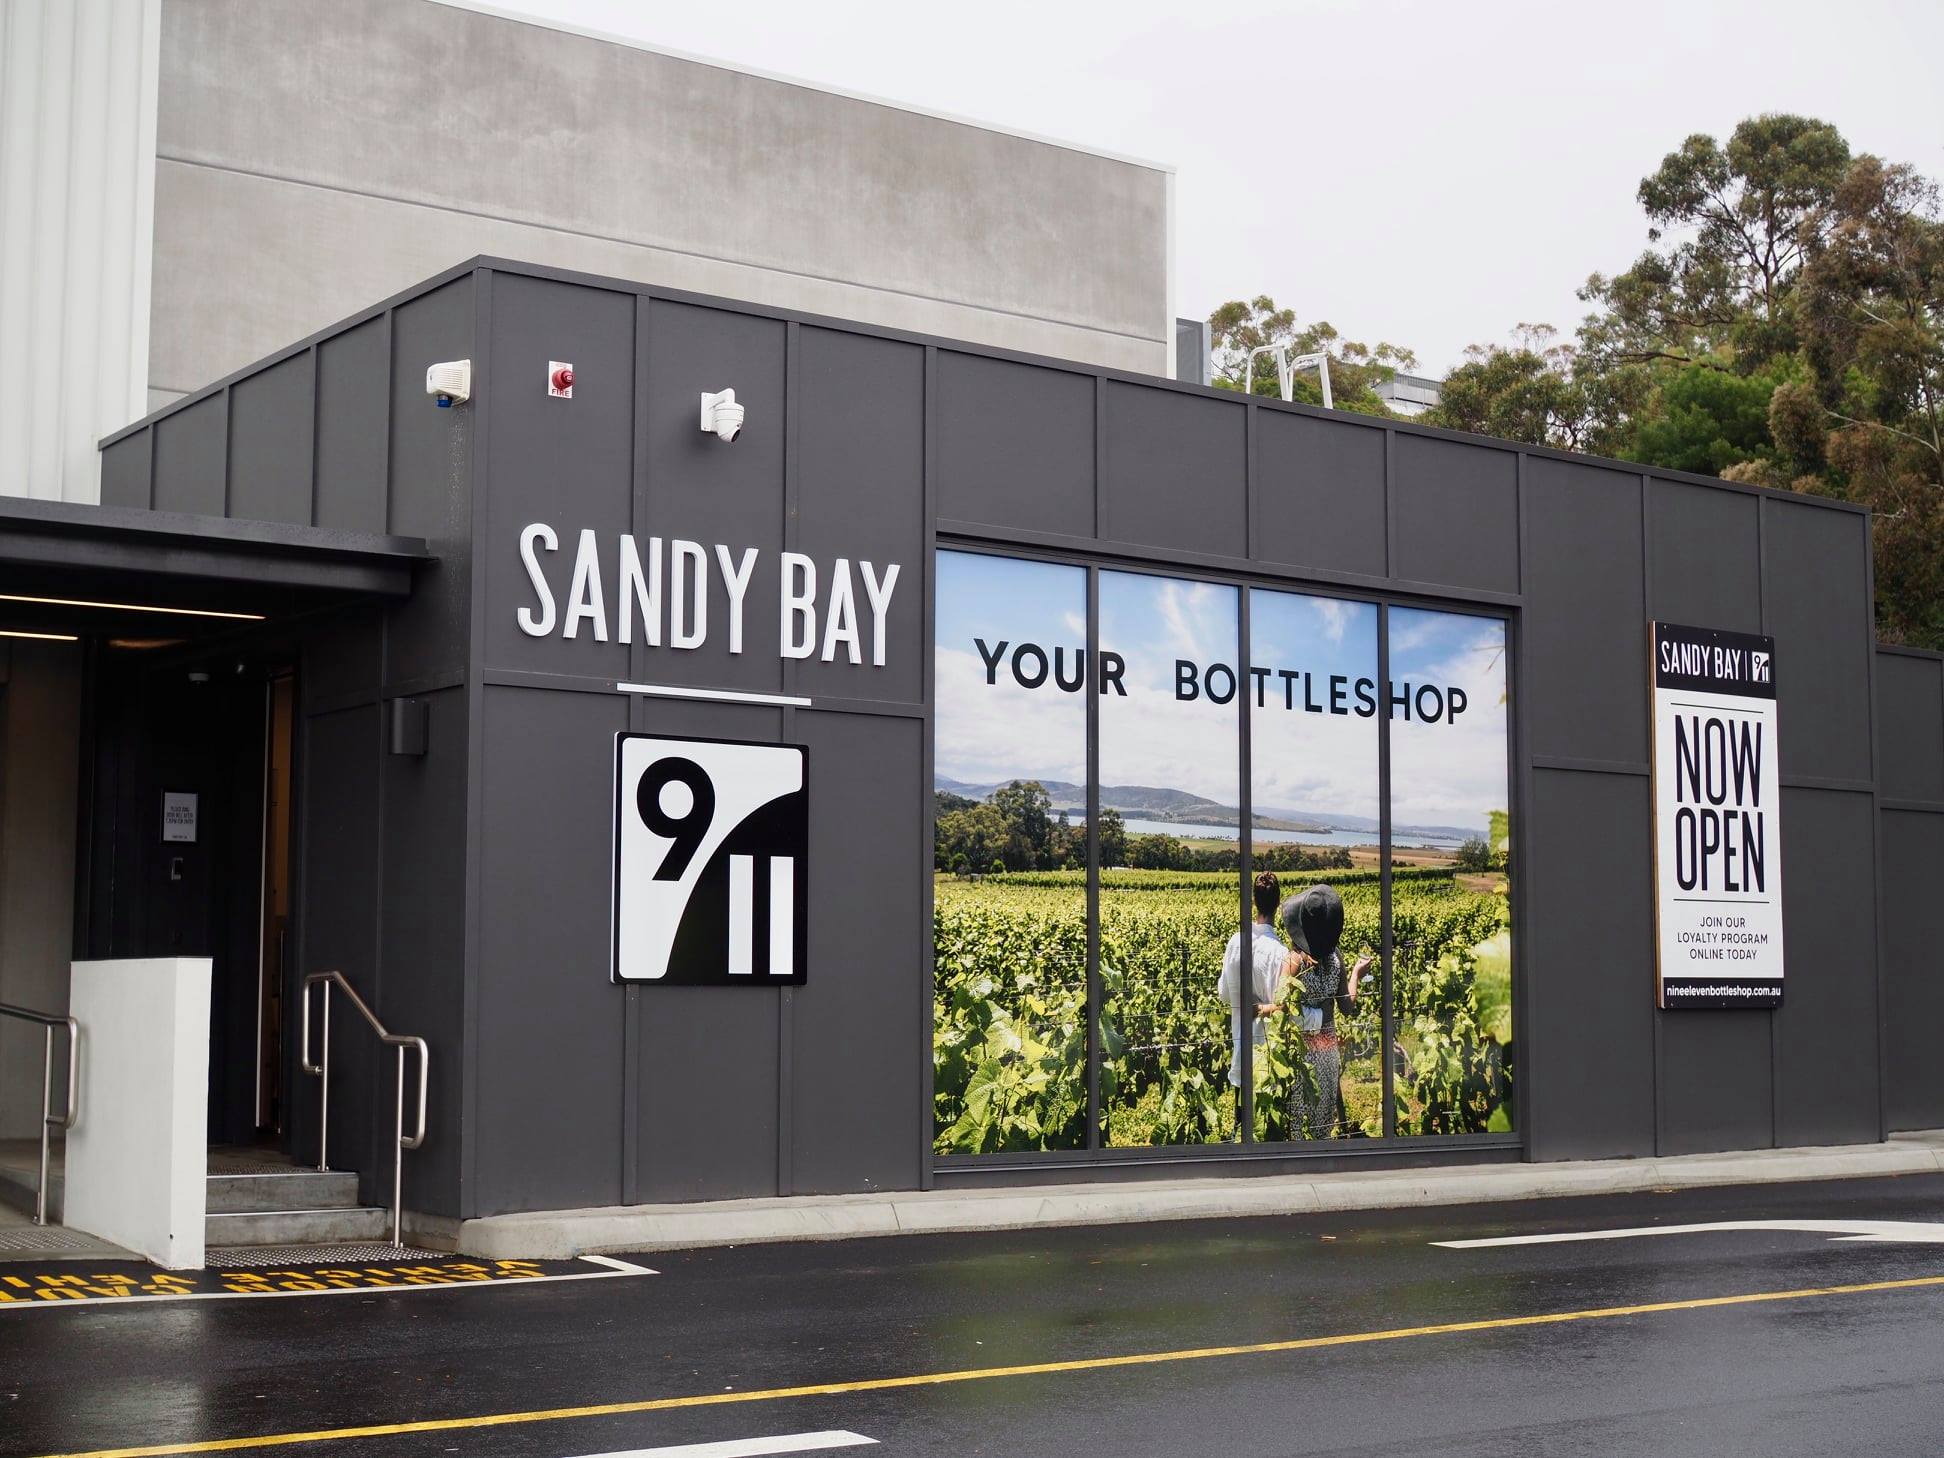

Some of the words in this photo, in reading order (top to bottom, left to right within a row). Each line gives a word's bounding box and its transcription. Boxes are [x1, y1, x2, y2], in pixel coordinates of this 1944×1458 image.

[551, 388, 570, 397] FIRE
[517, 523, 759, 654] SANDY
[780, 552, 900, 666] BAY
[1661, 640, 1710, 677] SANDY
[1714, 646, 1741, 680] BAY
[973, 638, 1128, 697] YOUR
[1175, 659, 1468, 725] BOTTLESHOP
[1675, 715, 1762, 808] NOW
[1675, 807, 1765, 893] OPEN
[1700, 916, 1723, 928] JOIN
[1725, 917, 1746, 928] OUR
[1677, 932, 1718, 944] LOYALTY
[1721, 933, 1768, 945] PROGRAM
[1689, 948, 1724, 960] ONLINE
[1726, 949, 1758, 960] TODAY
[1666, 985, 1782, 998] nineelevenbottleshop.com.au
[221, 1260, 542, 1283] VEHICLE
[223, 1269, 546, 1292] CAUTION
